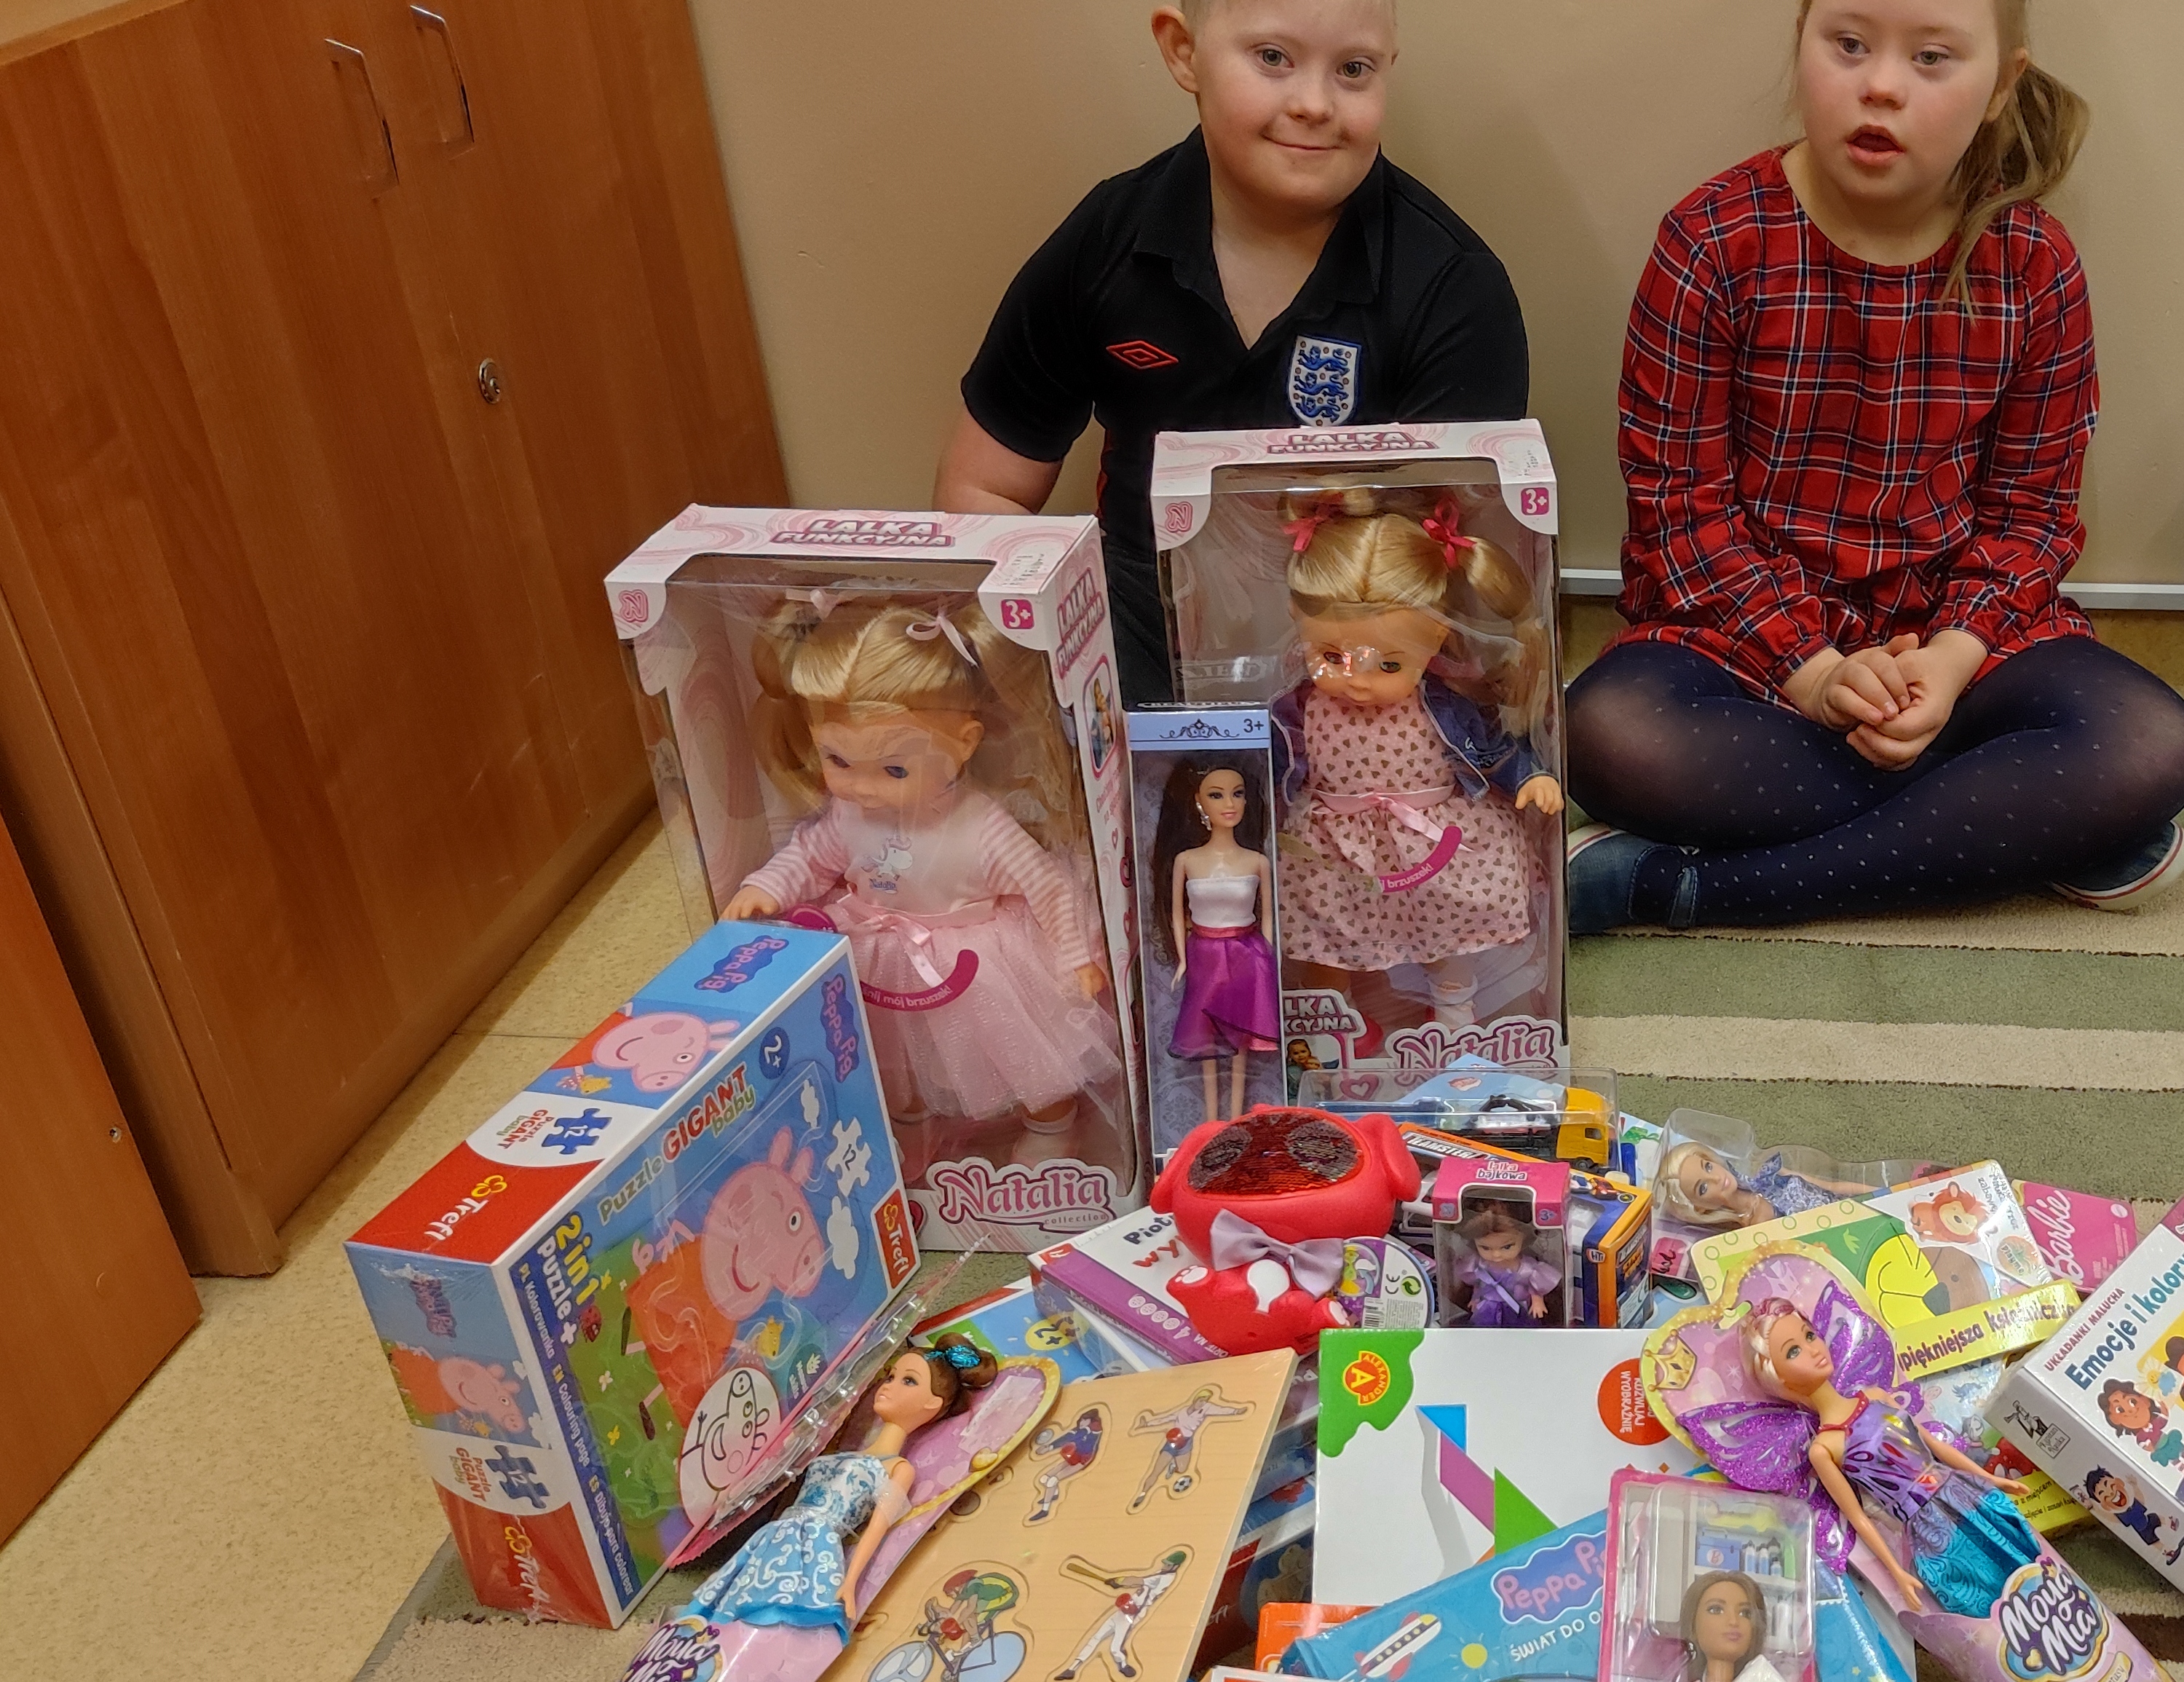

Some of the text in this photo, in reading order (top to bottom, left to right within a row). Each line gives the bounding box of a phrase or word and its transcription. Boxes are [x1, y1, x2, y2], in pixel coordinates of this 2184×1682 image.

[1270, 440, 1433, 454] FUNKCYJNA
[1291, 433, 1406, 445] LALKA
[1526, 488, 1548, 513] 3+
[775, 532, 949, 545] FUNKCYJNA
[807, 519, 934, 536] LALKA
[1005, 600, 1031, 628] 3+
[1243, 718, 1265, 733] 3+
[1387, 863, 1434, 888] brzuszek!
[697, 938, 787, 990] Peppa Pig
[1283, 996, 1337, 1018] LKA
[1283, 1016, 1354, 1033] KCYJNA
[823, 975, 856, 1083] Peppa Pig
[763, 1034, 783, 1069] 2+
[1396, 1025, 1552, 1078] Natalia
[497, 1109, 549, 1149] GIGANT
[563, 1124, 588, 1139] 12
[663, 1062, 746, 1162] GIGANT
[712, 1086, 756, 1137] baby
[842, 1143, 857, 1172] 12
[1477, 1168, 1527, 1180] bajkowa
[598, 1156, 663, 1225] Puzzle
[942, 1170, 1104, 1217] Natalia
[424, 1197, 489, 1241] Trefl
[1044, 1213, 1107, 1225] collection
[1123, 1215, 1175, 1245] Piot
[2027, 1189, 2084, 1286] Barbie
[889, 1223, 910, 1275] Trefl
[2043, 1322, 2091, 1372] UKŁADANKI
[2087, 1287, 2126, 1327] MALUCHA
[2064, 1318, 2138, 1391] Emocje
[2124, 1303, 2148, 1324] i
[1350, 1366, 1377, 1389] A
[1361, 1353, 1388, 1402] ALEXANDER
[1619, 1370, 1633, 1434] WYOBRAŹNIĘ
[524, 1280, 555, 1359] Kolorowanka
[558, 1382, 581, 1440] Colouring
[574, 1433, 590, 1467] page
[615, 1549, 635, 1597] colorear
[456, 1447, 487, 1503] GIGANT
[472, 1456, 492, 1493] Puzzle
[507, 1469, 529, 1488] 12
[1497, 1572, 1587, 1615] Peppa
[2002, 1564, 2075, 1654] Moya
[632, 1624, 716, 1674] Moya
[1510, 1629, 1557, 1662] ŚWIAT
[1559, 1618, 1586, 1638] DO
[2041, 1604, 2097, 1673] Mia
